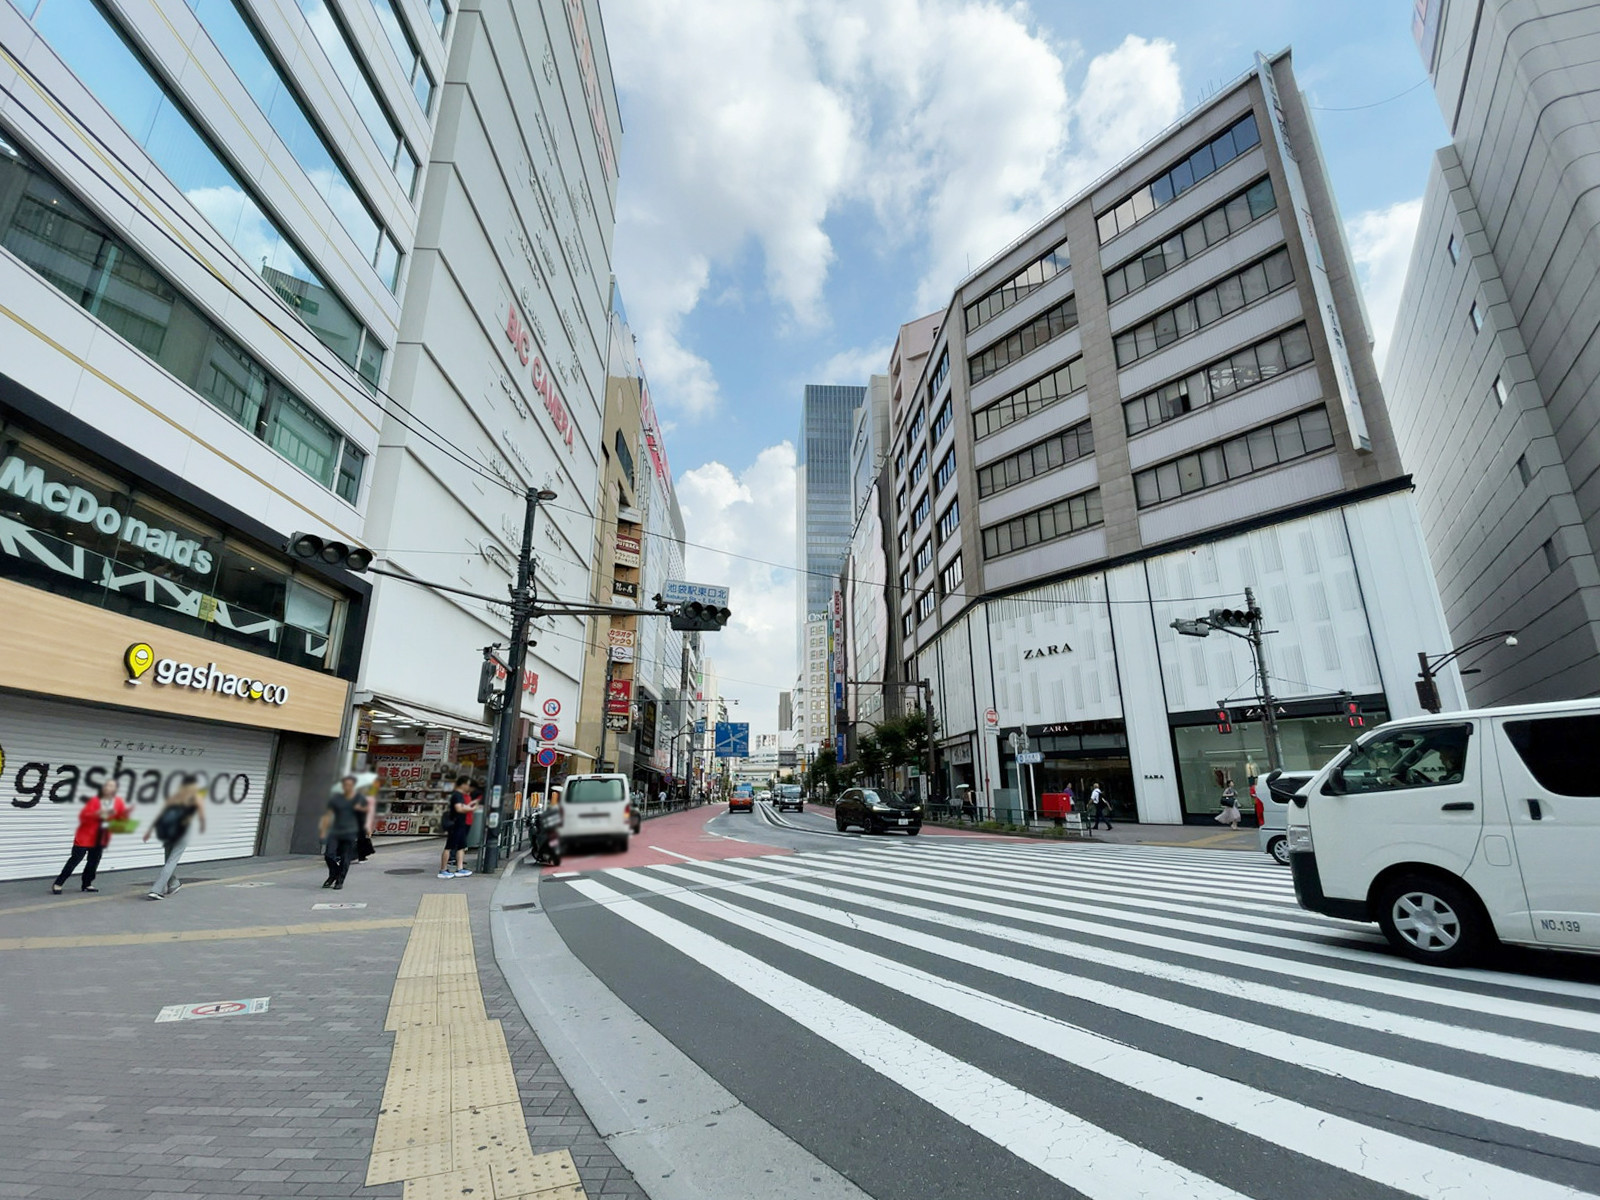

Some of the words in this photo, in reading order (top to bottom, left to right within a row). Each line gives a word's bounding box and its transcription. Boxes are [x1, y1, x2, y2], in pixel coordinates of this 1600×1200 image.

[505, 302, 531, 367] BIC
[531, 356, 574, 454] CAMERA
[0, 456, 214, 576] McDonald's
[667, 583, 727, 599] 池袋駅東口北
[610, 629, 632, 638] カラオケ
[610, 636, 626, 644] マック
[1024, 642, 1073, 660] ZARA
[155, 658, 289, 707] gashacoco
[1042, 725, 1069, 733] ZARA
[1540, 919, 1581, 933] NO.139
